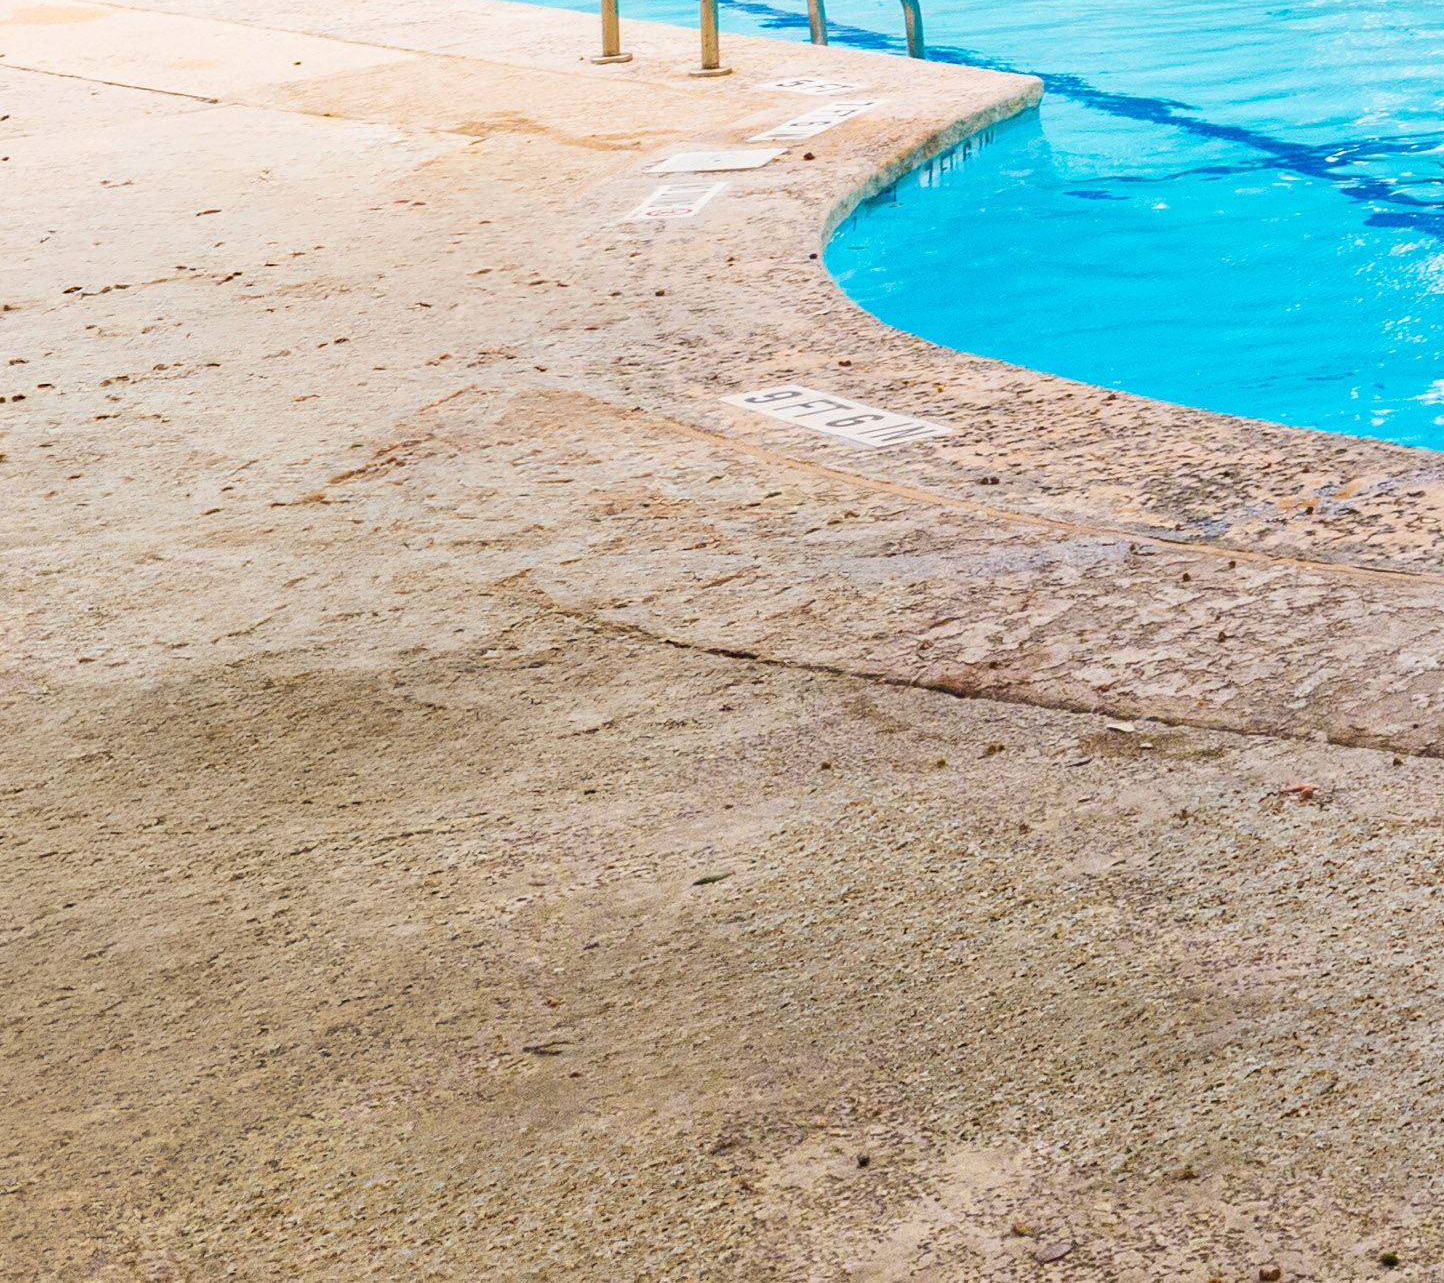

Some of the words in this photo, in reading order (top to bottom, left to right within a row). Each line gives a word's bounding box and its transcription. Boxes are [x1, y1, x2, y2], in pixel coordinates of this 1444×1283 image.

[744, 390, 802, 404] 9
[773, 399, 853, 418] FT
[825, 414, 884, 428] 6
[857, 423, 936, 442] IN
